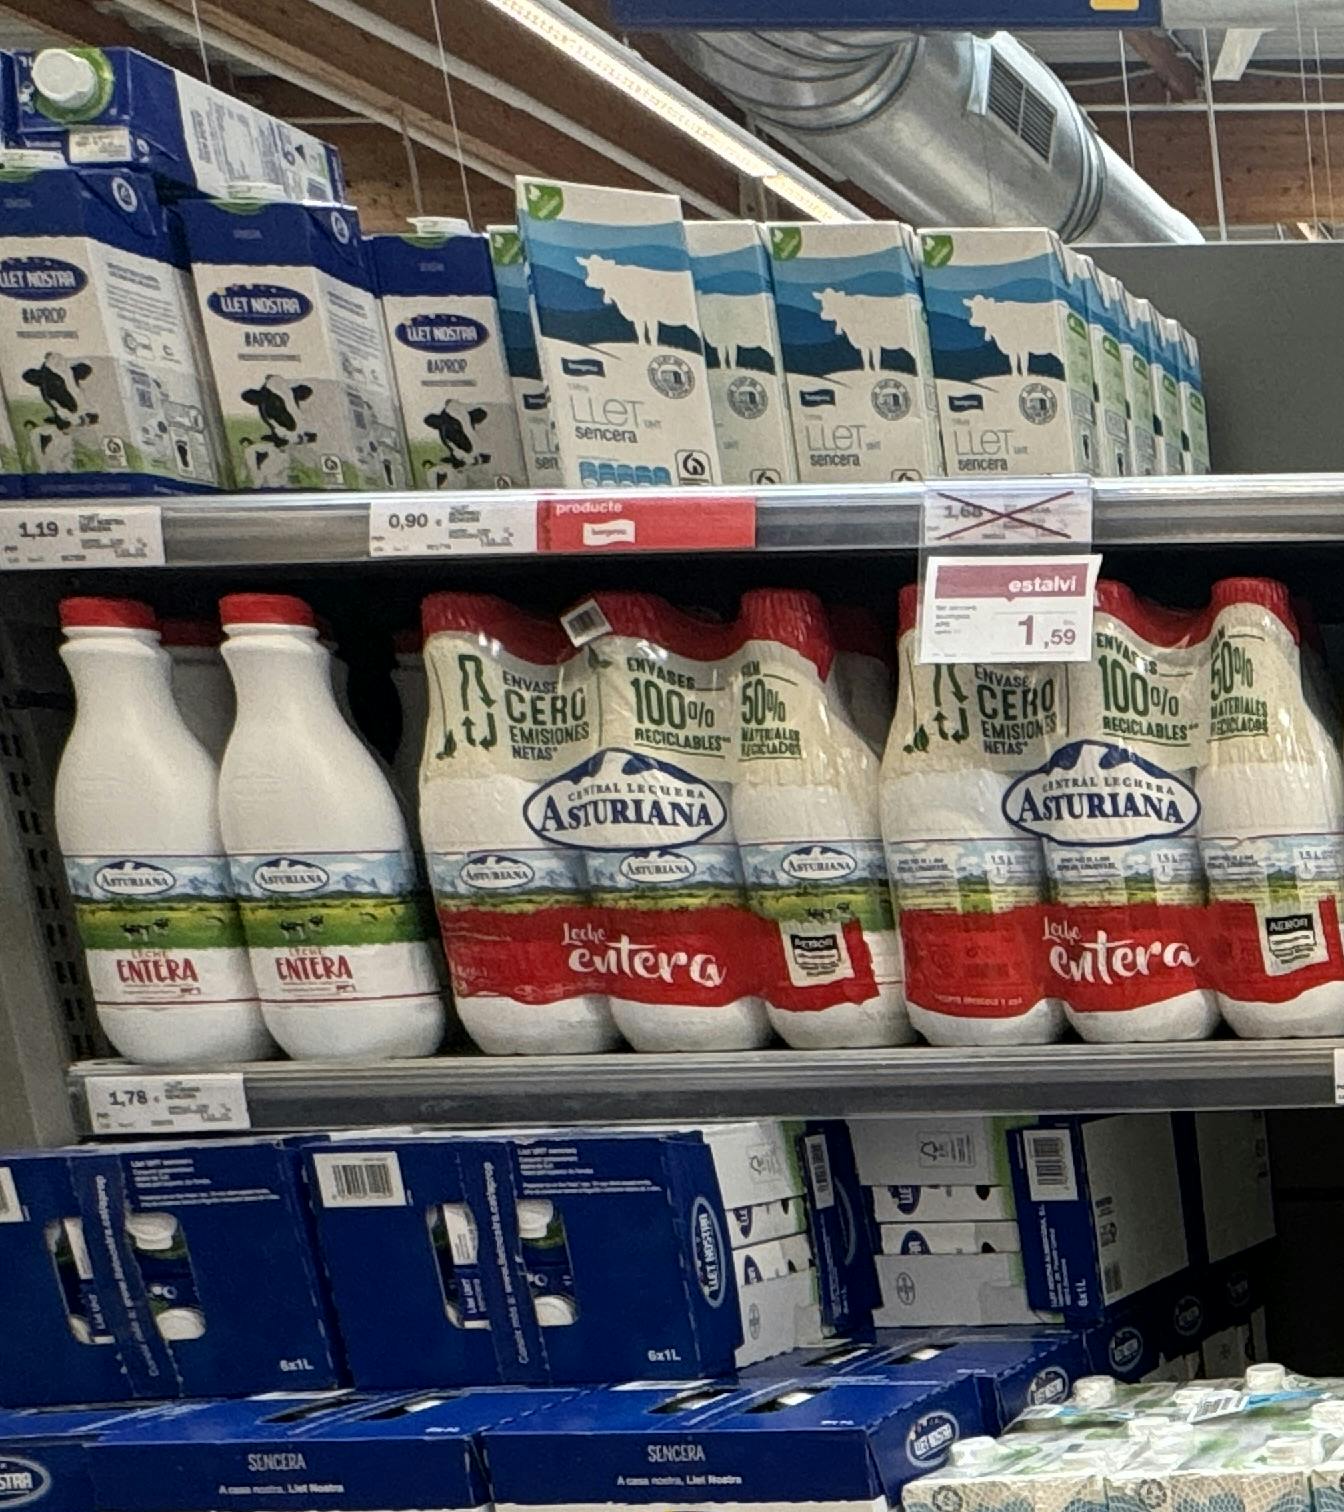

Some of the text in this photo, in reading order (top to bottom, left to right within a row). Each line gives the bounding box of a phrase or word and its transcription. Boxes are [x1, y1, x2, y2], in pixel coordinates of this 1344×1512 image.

[250, 298, 302, 314] NOSTRA
[432, 326, 478, 342] NOSTRA
[575, 426, 638, 444] sencera
[810, 453, 860, 468] sencera
[957, 456, 1008, 472] sencera
[555, 500, 622, 516] producte
[18, 520, 59, 540] 1,19
[388, 513, 429, 530] 0,90
[1007, 575, 1078, 593] estalvi
[1018, 614, 1076, 648] 1,59
[502, 670, 558, 695] ENVASE
[627, 657, 695, 690] ENVASES
[974, 665, 1031, 689] ENVASE
[1211, 640, 1254, 701] 50%
[1098, 654, 1180, 718] 100%
[504, 689, 587, 726] CERO
[630, 678, 716, 729] 100%
[740, 680, 786, 725] 50%
[976, 680, 1055, 722] CERO
[509, 722, 589, 744] EMISIONES
[982, 711, 1057, 739] EMISIONES
[539, 794, 714, 833] ASTURIANA
[1019, 790, 1185, 825] ASTURIANA
[116, 957, 200, 983] ENTERA
[275, 955, 354, 981] ENTERA
[567, 935, 727, 987] entera
[1049, 930, 1201, 986] entera
[109, 1090, 148, 1107] 1,78
[278, 1358, 314, 1372] 6x1L
[647, 1348, 681, 1363] 6x1L
[247, 1453, 306, 1471] SENCERA
[647, 1445, 705, 1462] SENCERA
